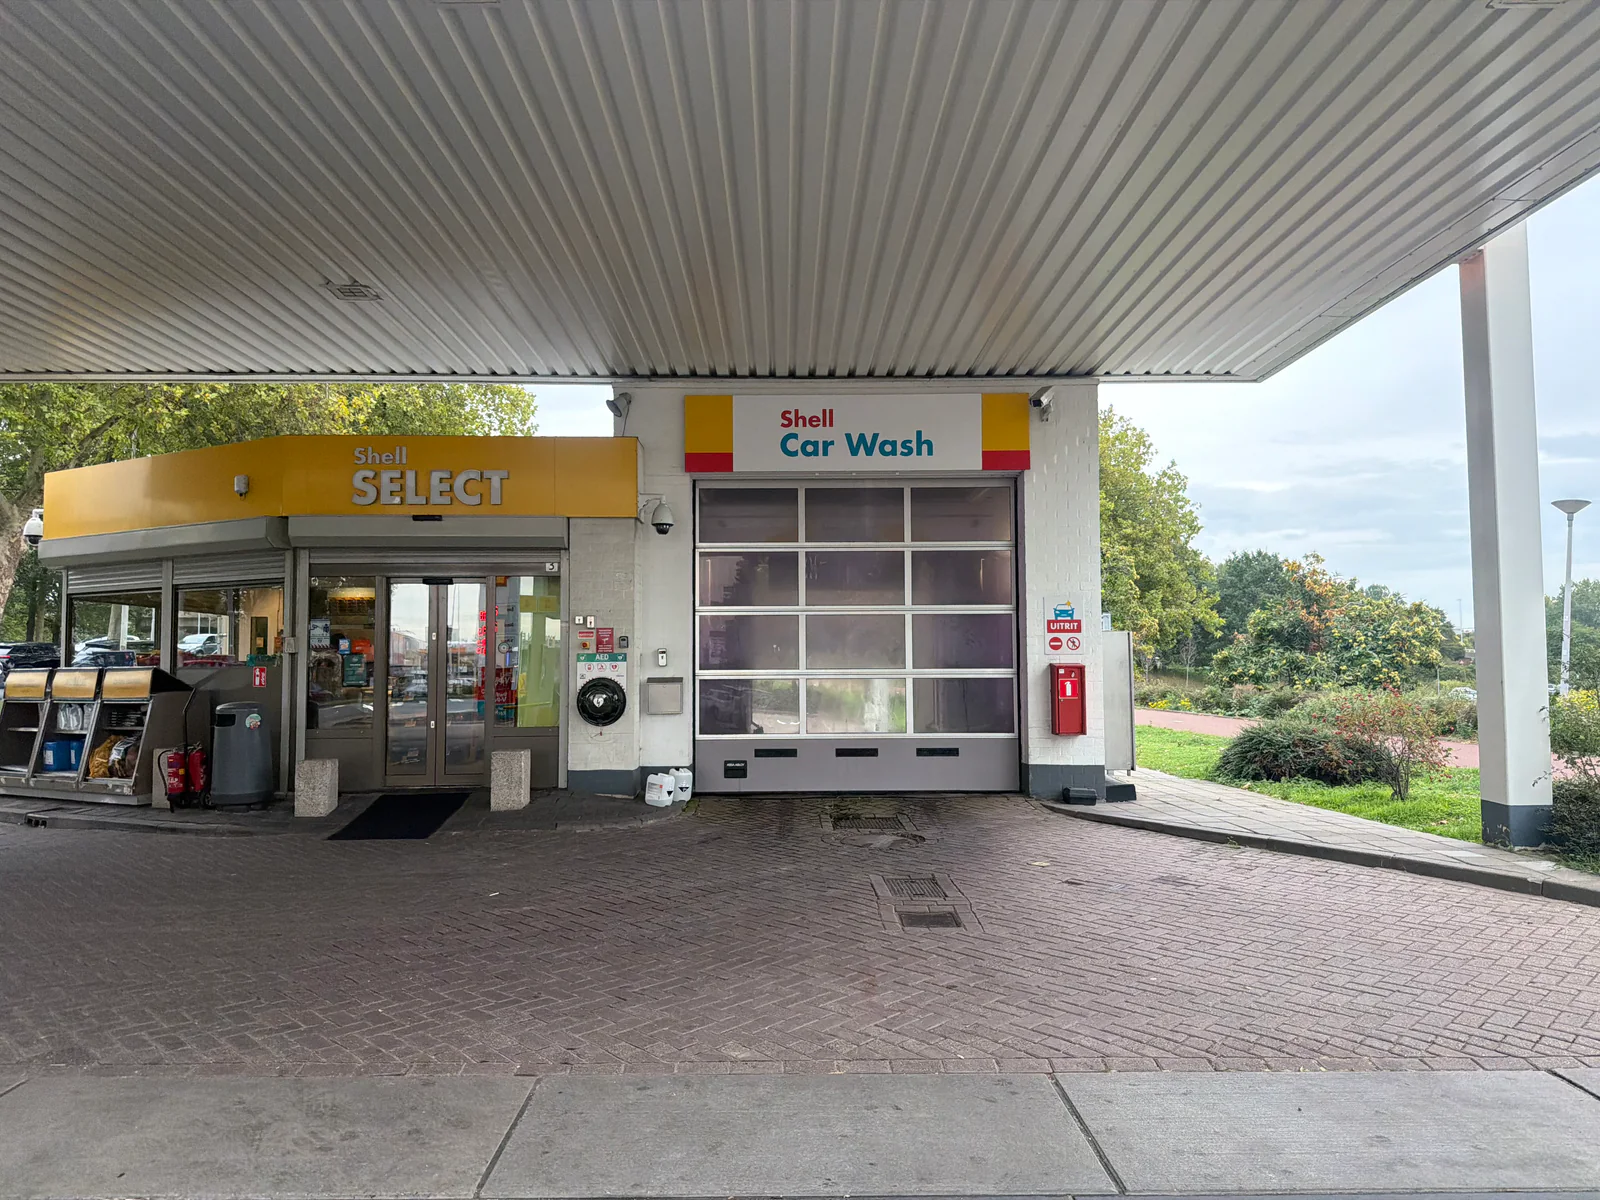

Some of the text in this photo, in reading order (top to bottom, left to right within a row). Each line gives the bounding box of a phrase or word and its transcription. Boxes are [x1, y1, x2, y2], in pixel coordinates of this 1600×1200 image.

[780, 409, 834, 428] Shell
[780, 430, 934, 457] Car Wash
[354, 446, 407, 465] Shell
[352, 470, 509, 506] SELECT
[1050, 622, 1078, 630] UITRIT
[595, 653, 609, 661] AED
